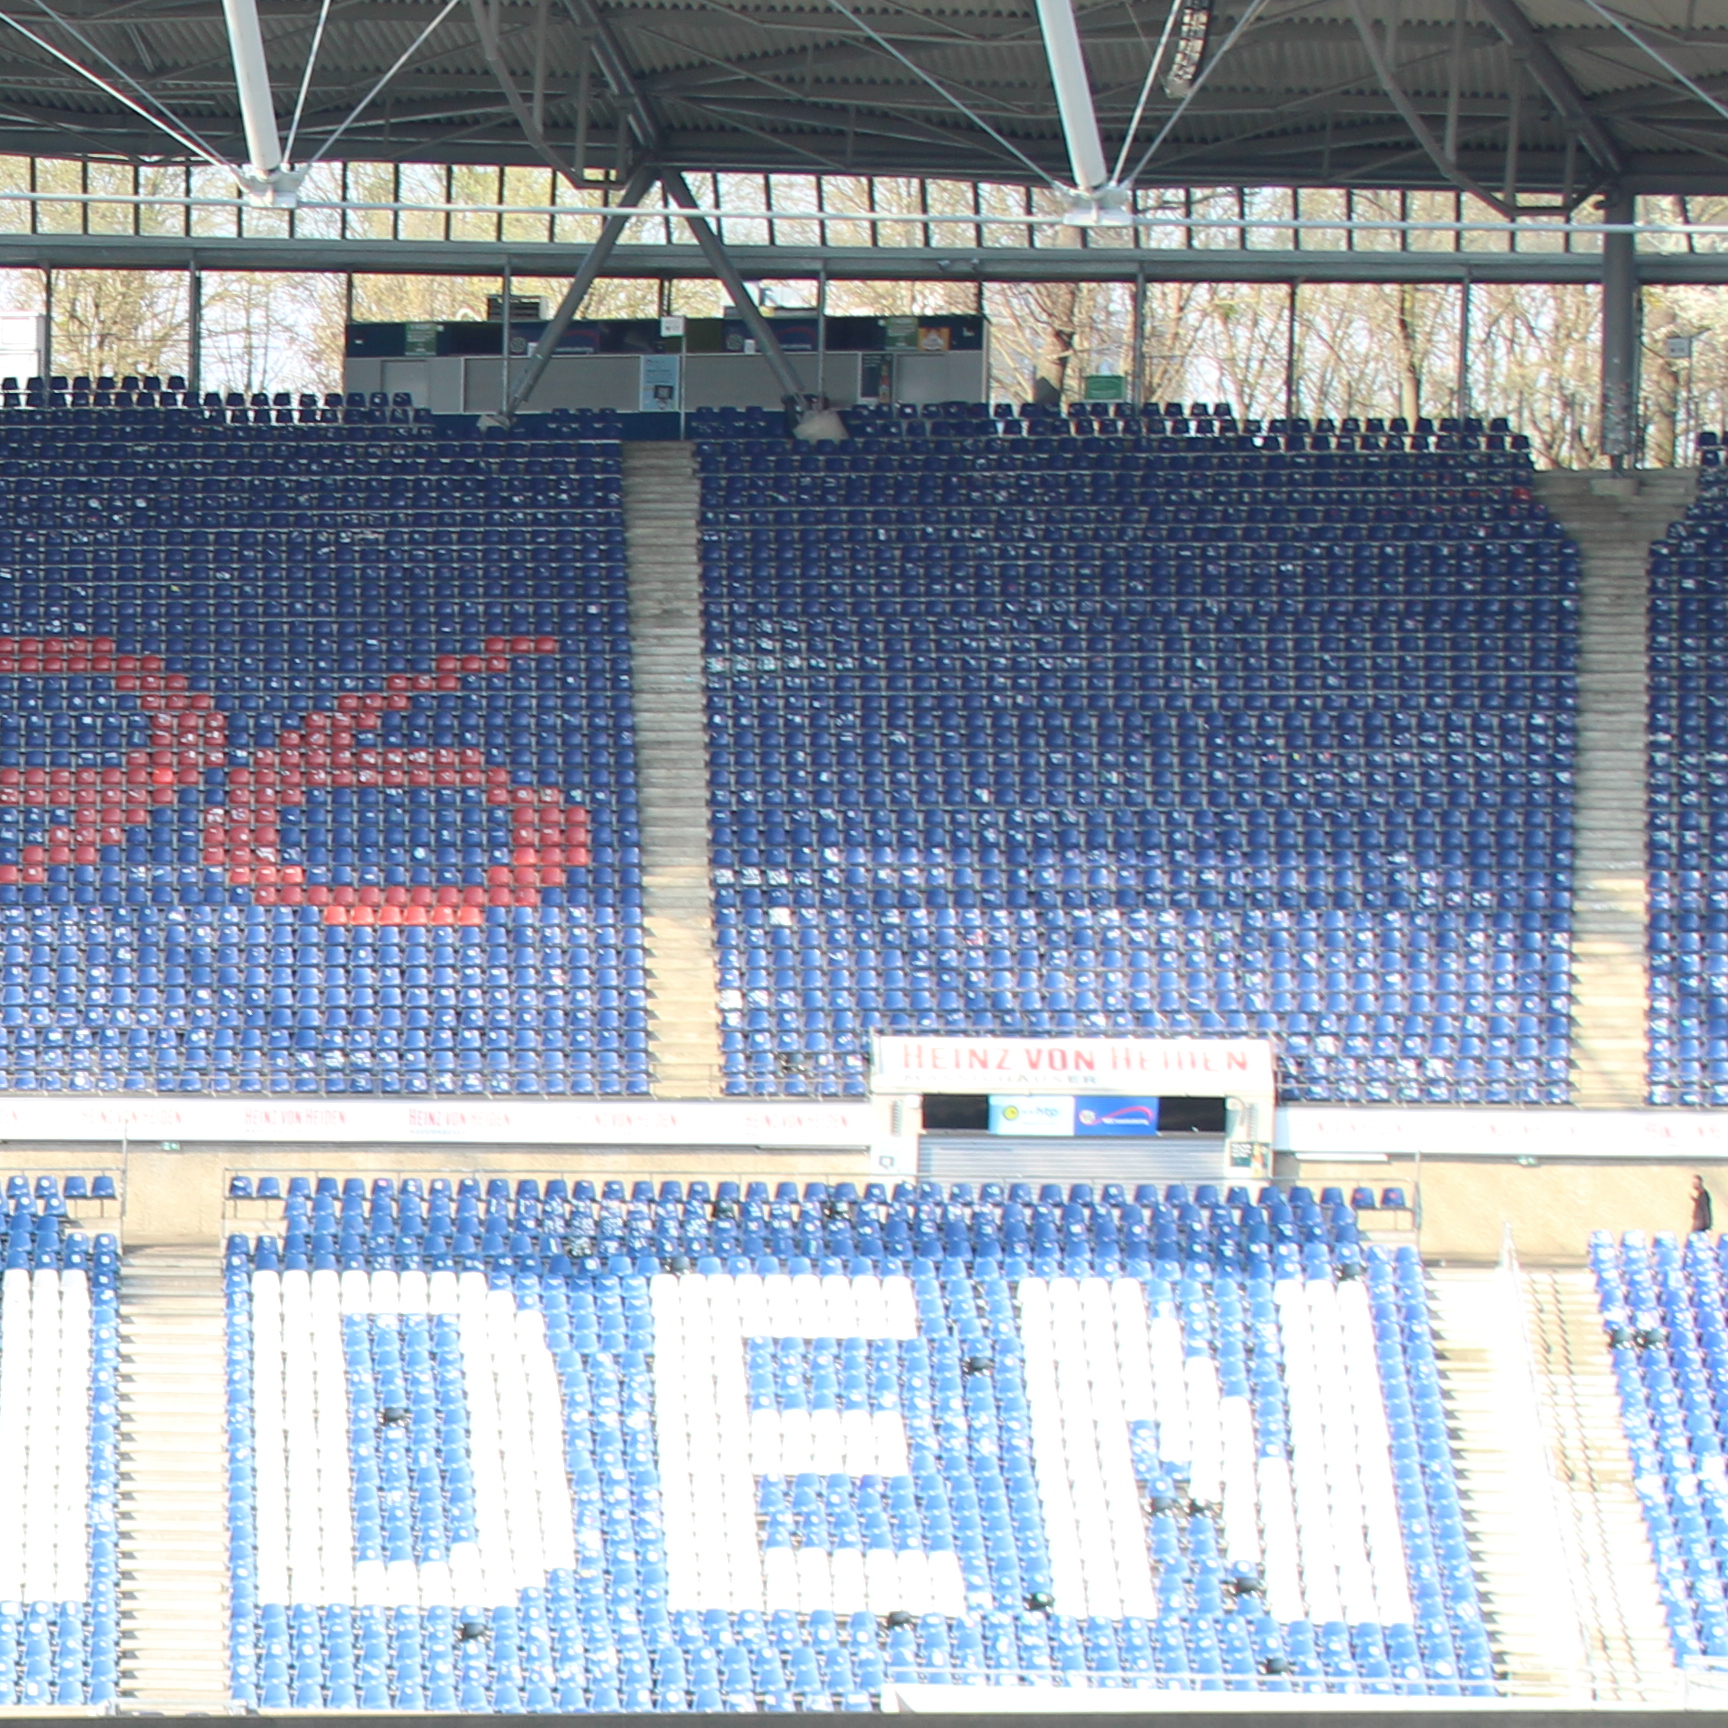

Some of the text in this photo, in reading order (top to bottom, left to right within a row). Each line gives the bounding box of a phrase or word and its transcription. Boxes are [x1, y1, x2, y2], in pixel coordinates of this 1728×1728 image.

[902, 1043, 1011, 1071] HEINZ
[1023, 1046, 1096, 1072] VON
[281, 1110, 302, 1125] VON
